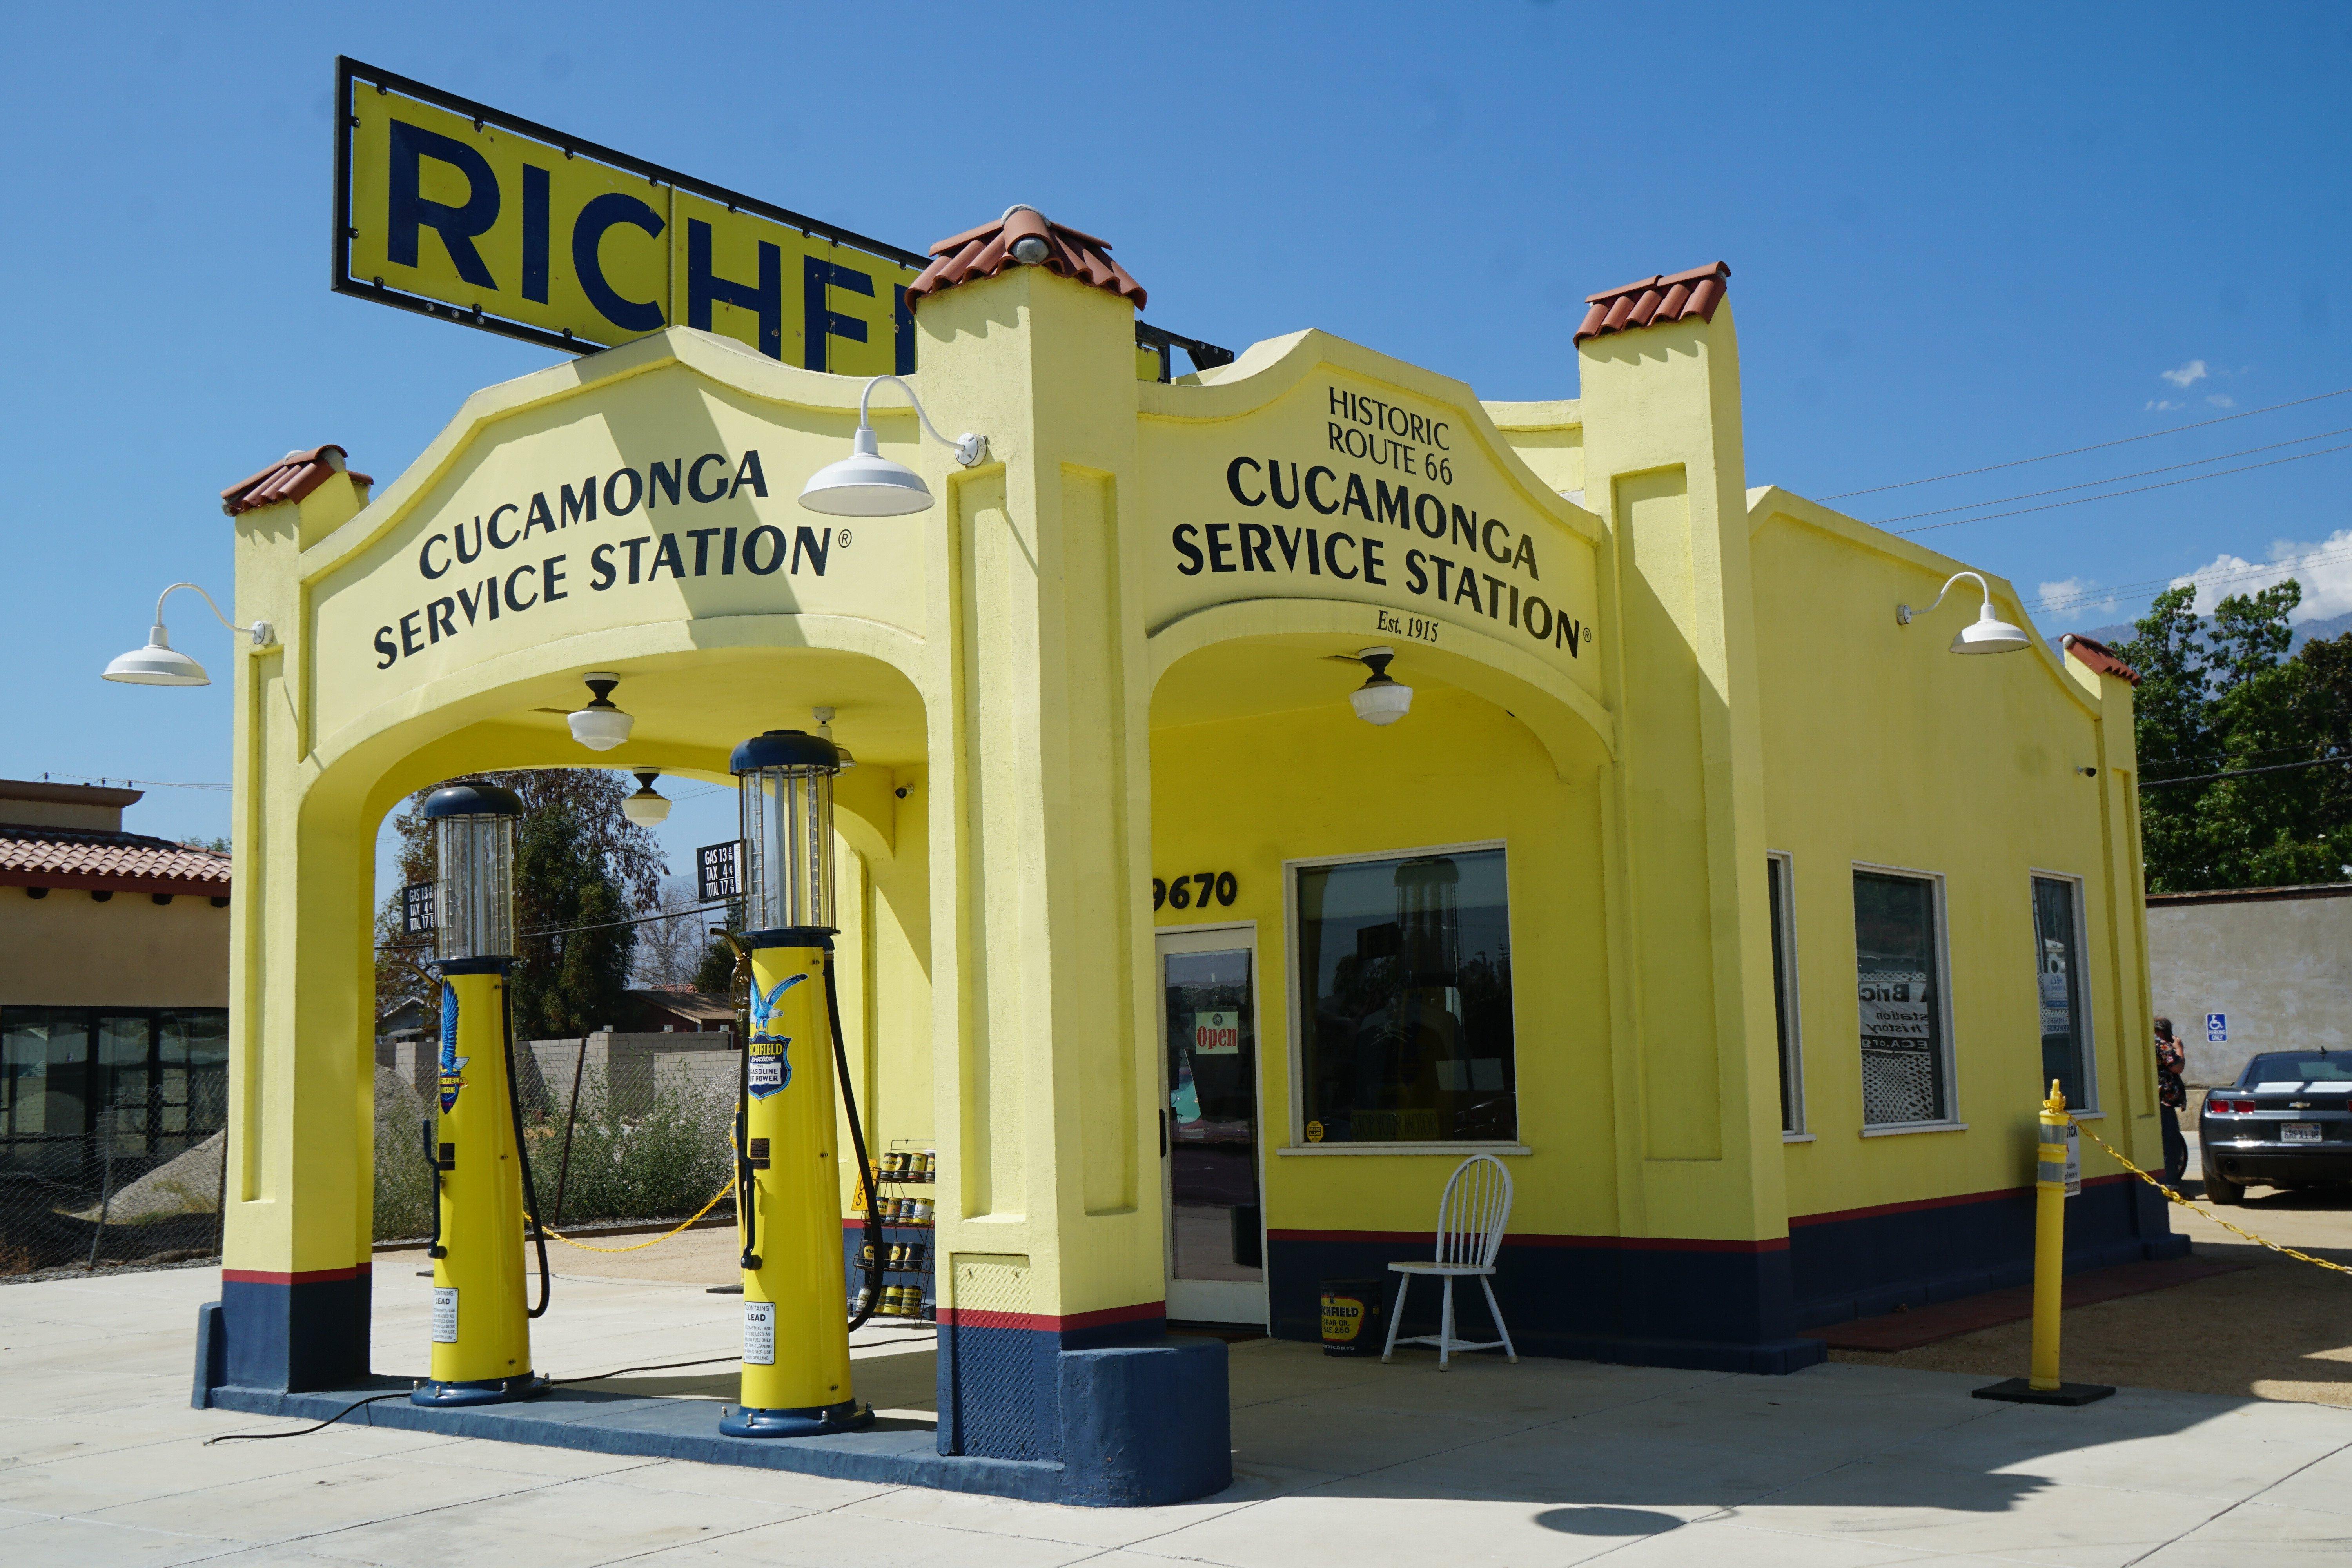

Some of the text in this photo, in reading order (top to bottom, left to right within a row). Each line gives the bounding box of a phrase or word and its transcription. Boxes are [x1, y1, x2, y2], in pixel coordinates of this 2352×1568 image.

[1329, 386, 1450, 451] HISTORIC
[1328, 421, 1453, 486] ROUTE 66
[420, 450, 769, 580] CUCAMONGA
[1227, 456, 1539, 581] CUCAMONGA
[1172, 523, 1387, 586] SERVICE
[373, 554, 568, 670] SERVICE
[1377, 610, 1439, 642] Est. 1915
[705, 849, 717, 865] GAS
[719, 848, 727, 862] 13
[705, 866, 718, 881] TAX
[409, 888, 420, 902] GAS
[421, 887, 428, 900] 13
[706, 882, 719, 897] TOTAL
[720, 880, 728, 895] 17
[1152, 871, 1237, 911] 9670
[409, 903, 420, 917] TAX
[409, 917, 421, 931] TOTAL
[422, 915, 428, 929] 17
[1197, 1026, 1237, 1050] Open
[2284, 1130, 2319, 1139] 6RFX138
